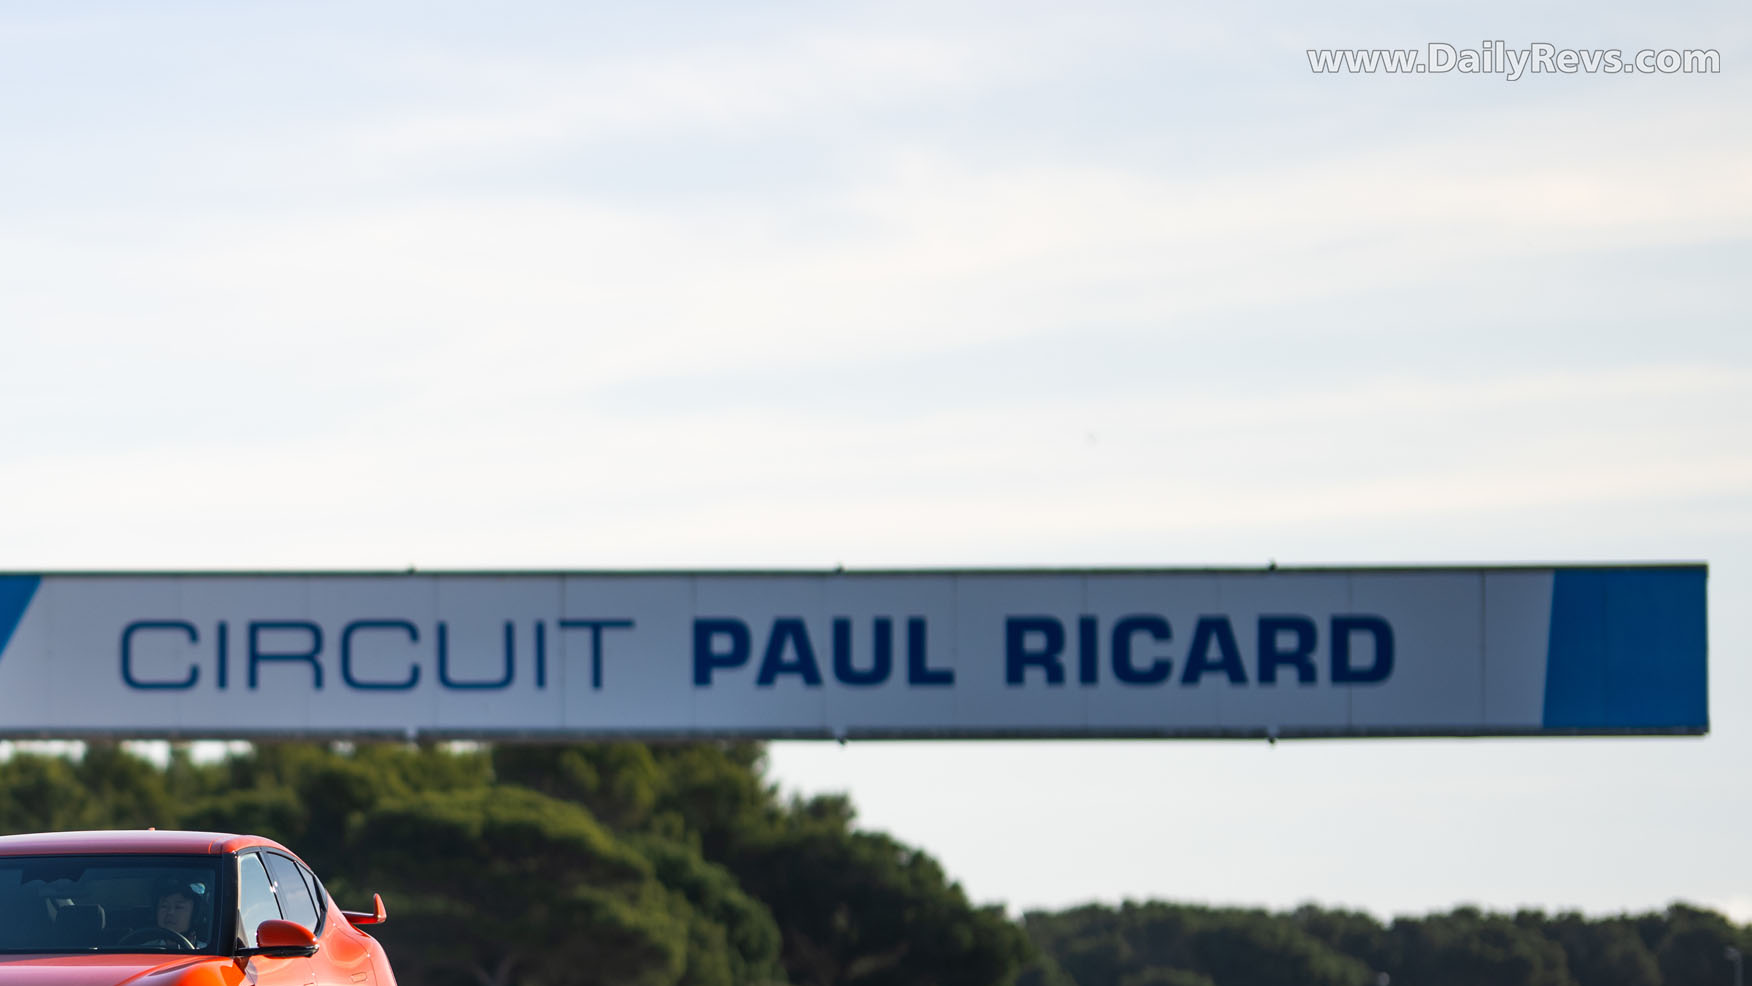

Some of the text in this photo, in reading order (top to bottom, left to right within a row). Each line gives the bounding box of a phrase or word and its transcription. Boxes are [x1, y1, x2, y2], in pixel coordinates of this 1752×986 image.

[118, 614, 1395, 693] CIRCUIT PAUL RICARD
